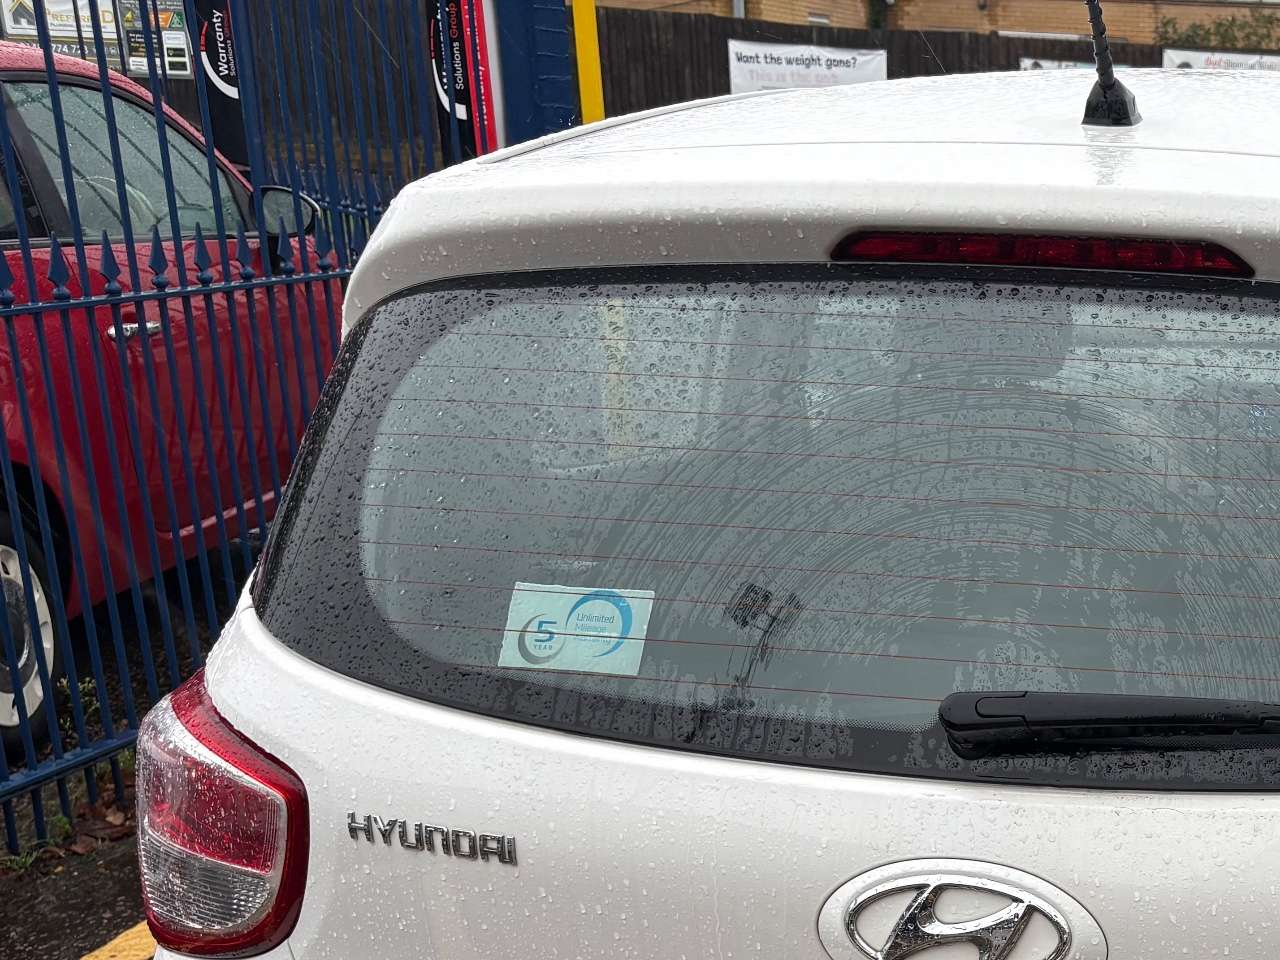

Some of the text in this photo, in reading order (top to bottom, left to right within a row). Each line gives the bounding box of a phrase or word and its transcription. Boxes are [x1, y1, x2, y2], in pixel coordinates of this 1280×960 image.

[212, 9, 229, 76] Warranty
[227, 40, 238, 77] Solutions
[448, 2, 464, 90] Solutions Group
[735, 51, 857, 70] Want the weight gone?
[534, 620, 557, 642] 5
[576, 612, 615, 624] Unlimited
[347, 811, 518, 866] HYUNDAI
